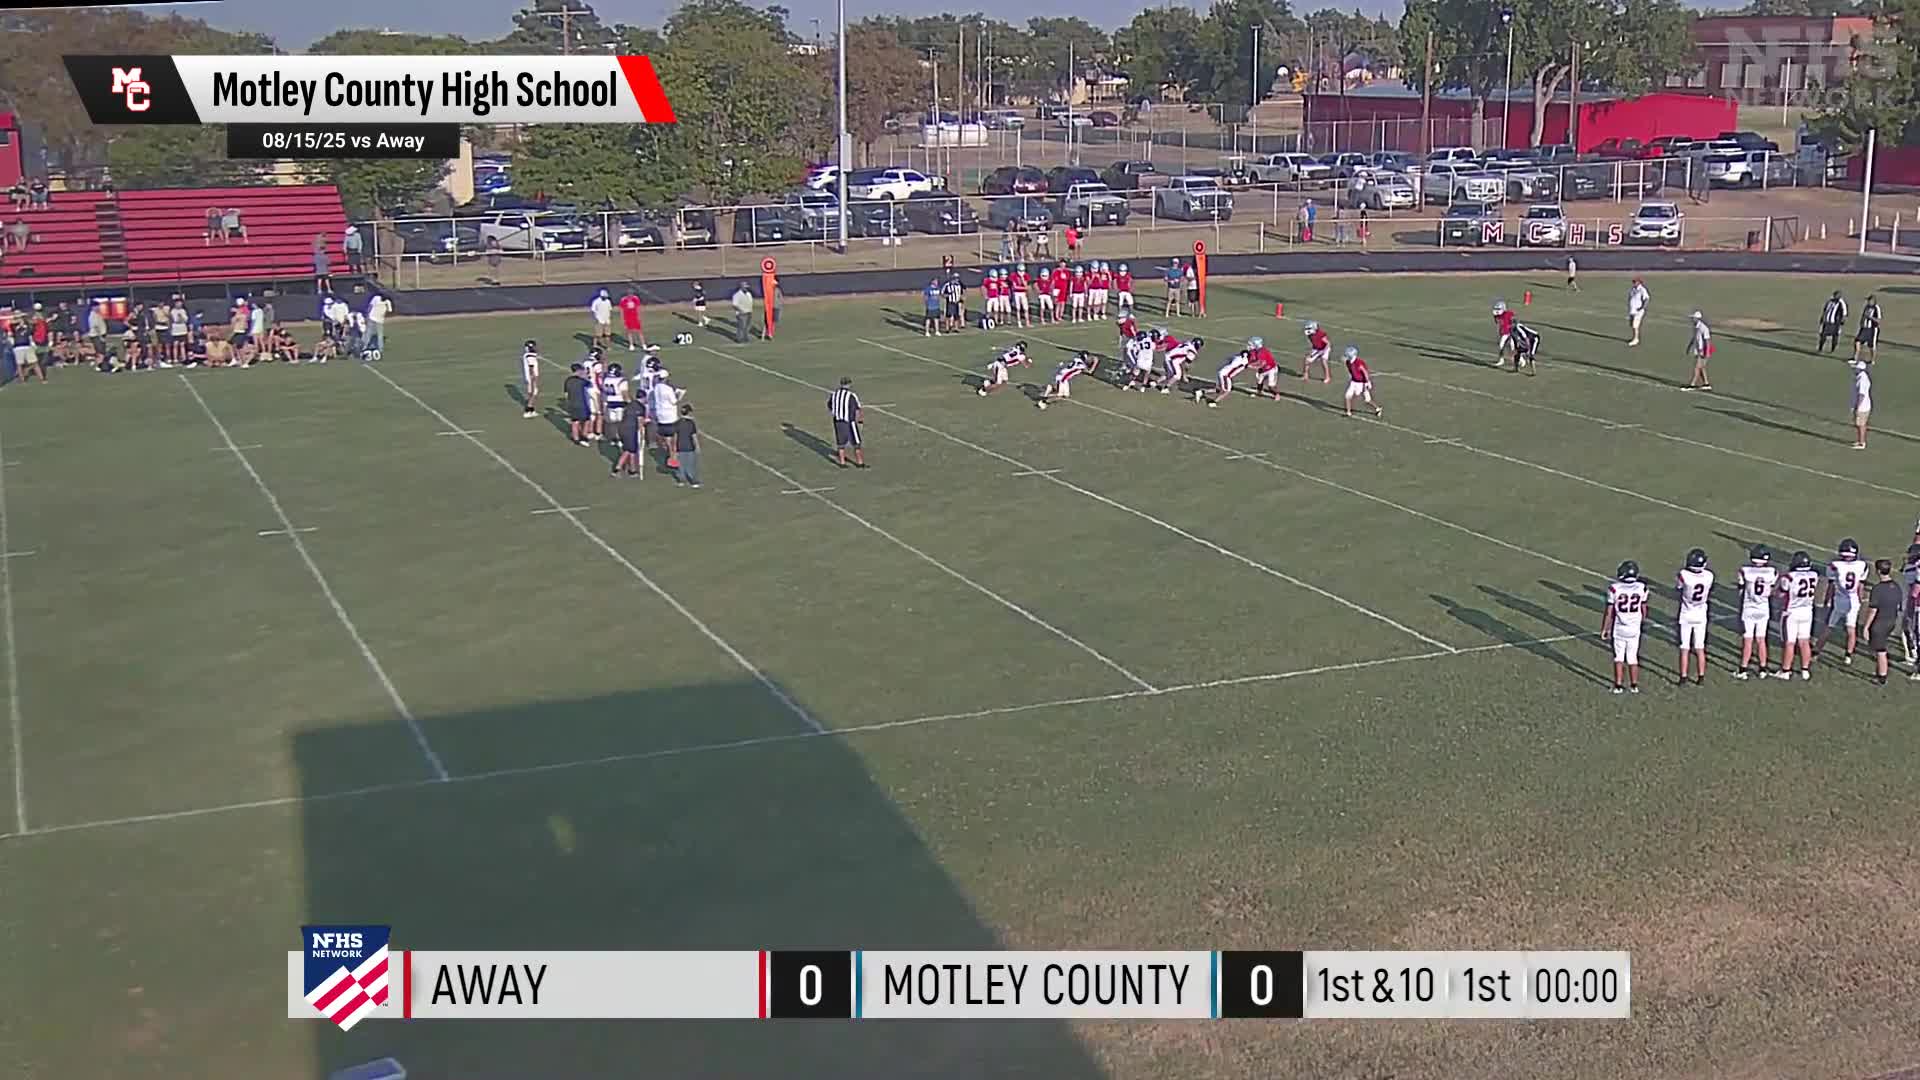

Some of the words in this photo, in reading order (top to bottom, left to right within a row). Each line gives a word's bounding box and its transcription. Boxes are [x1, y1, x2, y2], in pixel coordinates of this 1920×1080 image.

[677, 333, 693, 344] 20
[363, 349, 381, 361] 30
[1753, 577, 1764, 596] 6
[1797, 577, 1816, 598] 25
[1844, 571, 1856, 590] 9
[1692, 583, 1704, 602] 2
[1616, 592, 1642, 613] 22
